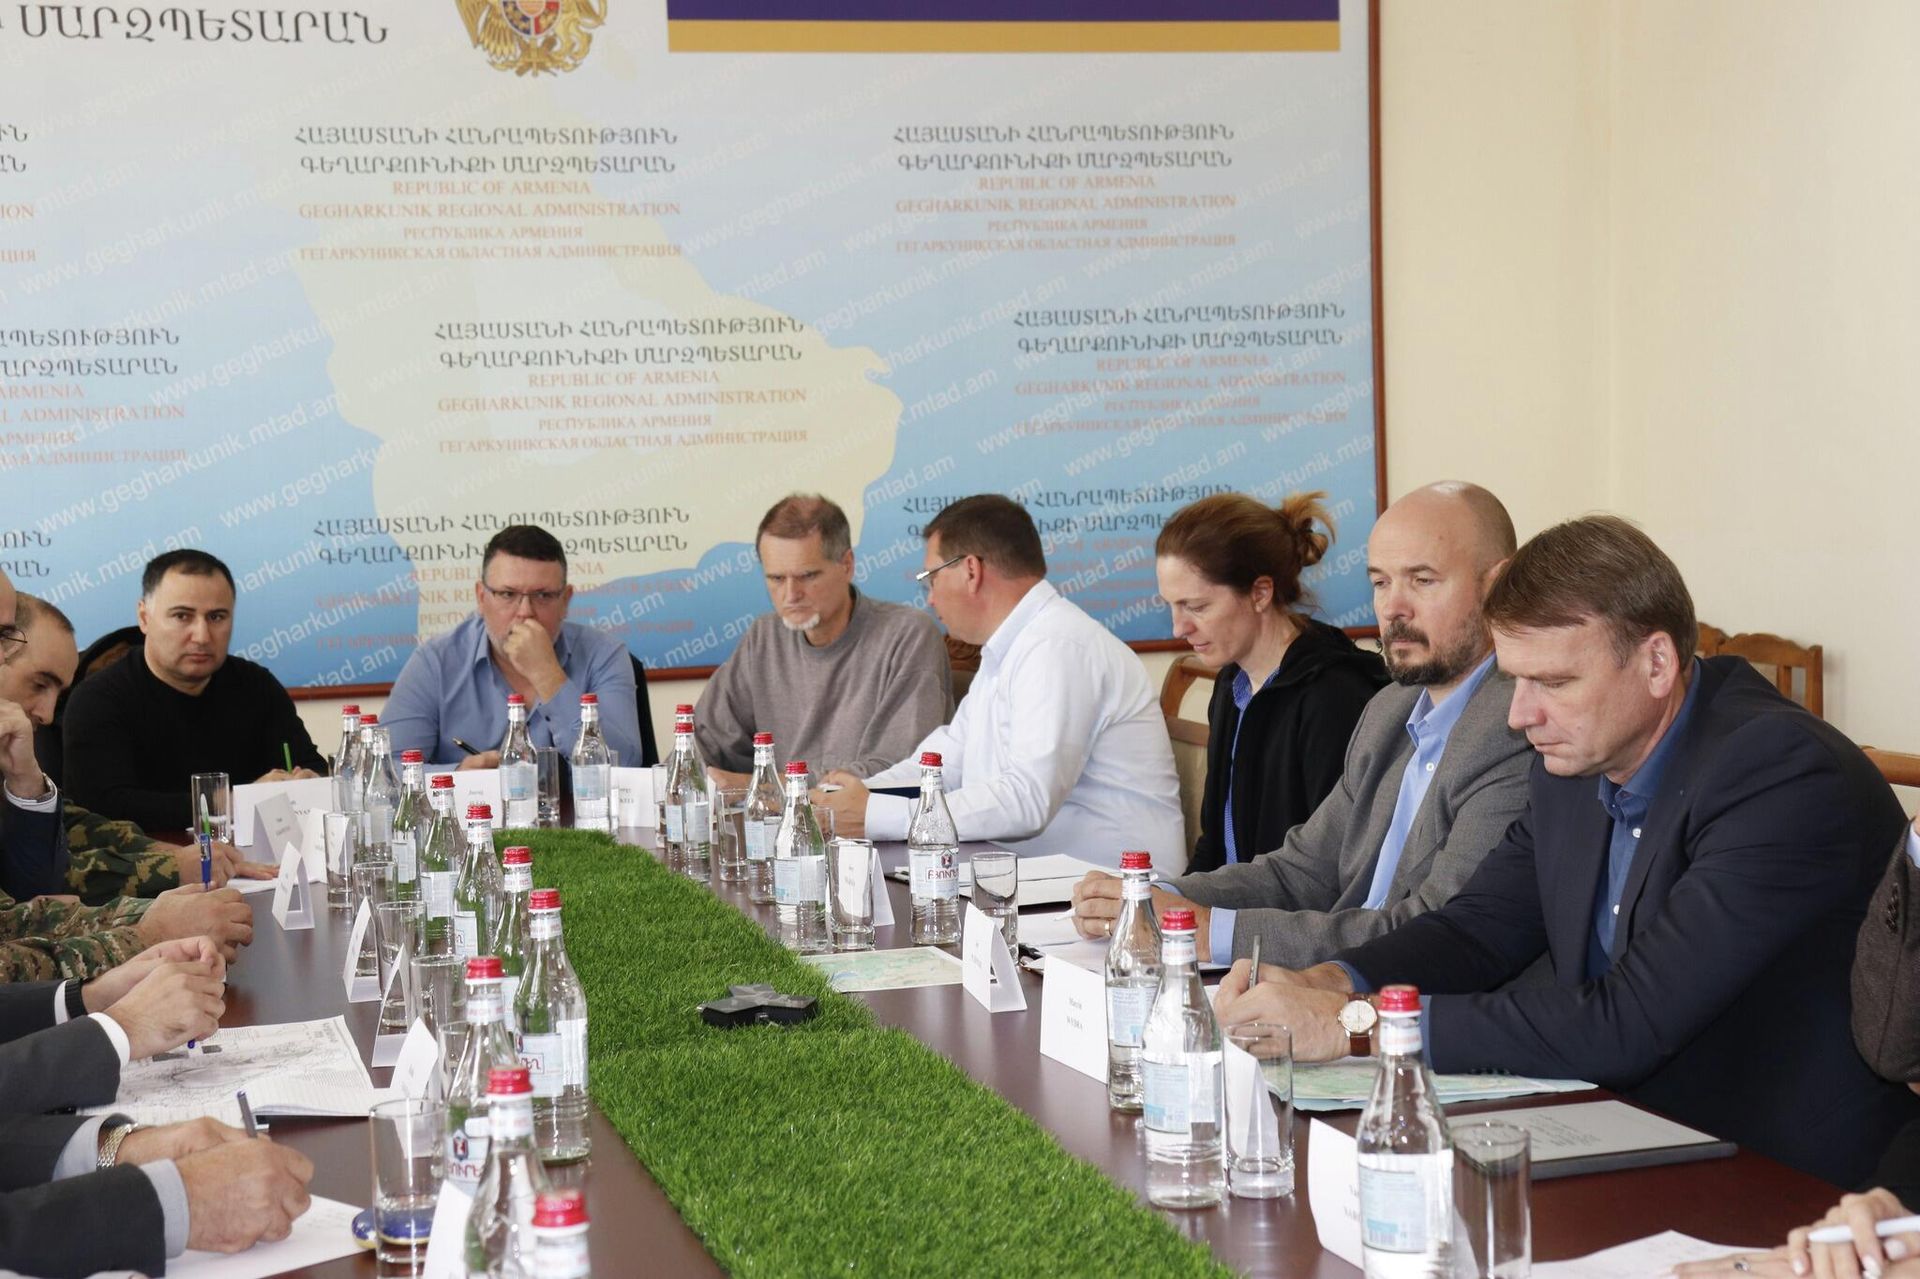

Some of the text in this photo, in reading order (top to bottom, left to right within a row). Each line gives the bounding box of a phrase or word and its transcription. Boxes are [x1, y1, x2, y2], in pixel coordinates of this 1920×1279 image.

[18, 4, 389, 45] ՄԱՐԶՊԵՏԱՐԱՆ
[295, 126, 678, 145] ՀԱՅԱՍՏԱՆԻ ՀԱՆՐԱՊԵՏՈՒԹՅՈՒՆ
[894, 125, 1020, 143] ՀԱՅԱՍՏԱՆԻ
[1027, 124, 1234, 142] ՀԱՆՐԱՊԵՏՈՒԹՅՈՒՆ
[301, 156, 675, 174] ԳԵՂԱՐՔՈՒՆԻՔԻ ՄԱՐԶՊԵՏԱՐԱՆ
[898, 150, 1232, 171] ԳԵՂԱՐՔՈՒՆԻՔԻ ՄԱՐԶՊԵՏԱՐԱՆ
[392, 180, 592, 195] REPUBLIC OF ARMENIA
[978, 174, 1155, 190] REPUBLIC OF ARMENIA
[299, 202, 681, 218] GEGHARKUNIK REGIONAL ADMINISTRATION
[896, 195, 1237, 213] GEGHARKUNIK REGIONAL ADMINISTRATION
[510, 226, 583, 239] АРМЕНИЯ
[435, 317, 804, 340] ՀԱՅԱՍՏԱՆԻ ՀԱՆՐԱՊԵՏՈՒԹՅՈՒՆ
[440, 344, 802, 369] ԳԵՂԱՐՔՈՒՆԻՔԻ ՄԱՐԶՊԵՏԱՐԱՆ
[0, 357, 178, 378] ԱՐԶՊԵՏԱՐԱՆ
[528, 369, 720, 388] REPUBLIC OF ARMENIA
[438, 388, 808, 412] GEGHARKUNIK REGIONAL ADMINISTRATION
[538, 414, 713, 431] РЕСПУБЛИКА АРМЕНИЯ
[582, 435, 673, 450] ОБЛАСТНАЯ
[677, 430, 808, 447] АДМИНИСТРАЦИЯ
[36, 388, 349, 536] www.gegharkunik.mtad.am
[313, 515, 454, 536] ՀԱՅԱՍՏԱՆԻ
